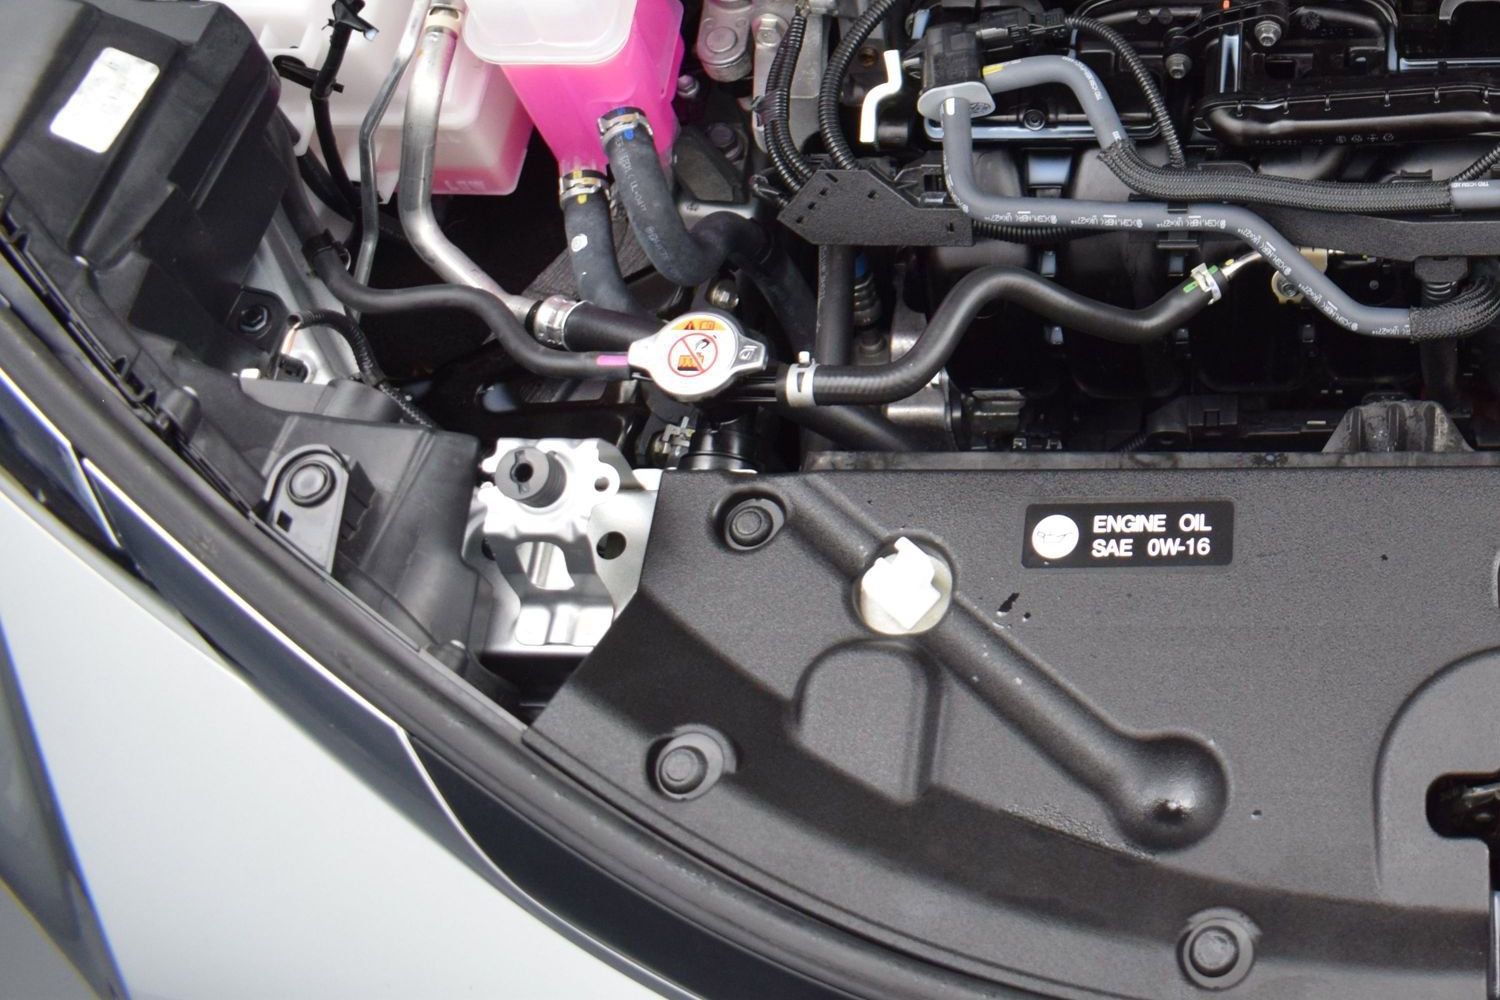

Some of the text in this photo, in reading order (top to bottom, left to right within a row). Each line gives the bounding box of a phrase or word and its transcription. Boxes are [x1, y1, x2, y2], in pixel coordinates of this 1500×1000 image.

[1093, 513, 1212, 533] ENGINE OIL
[1091, 537, 1211, 557] SAE 0W-16
